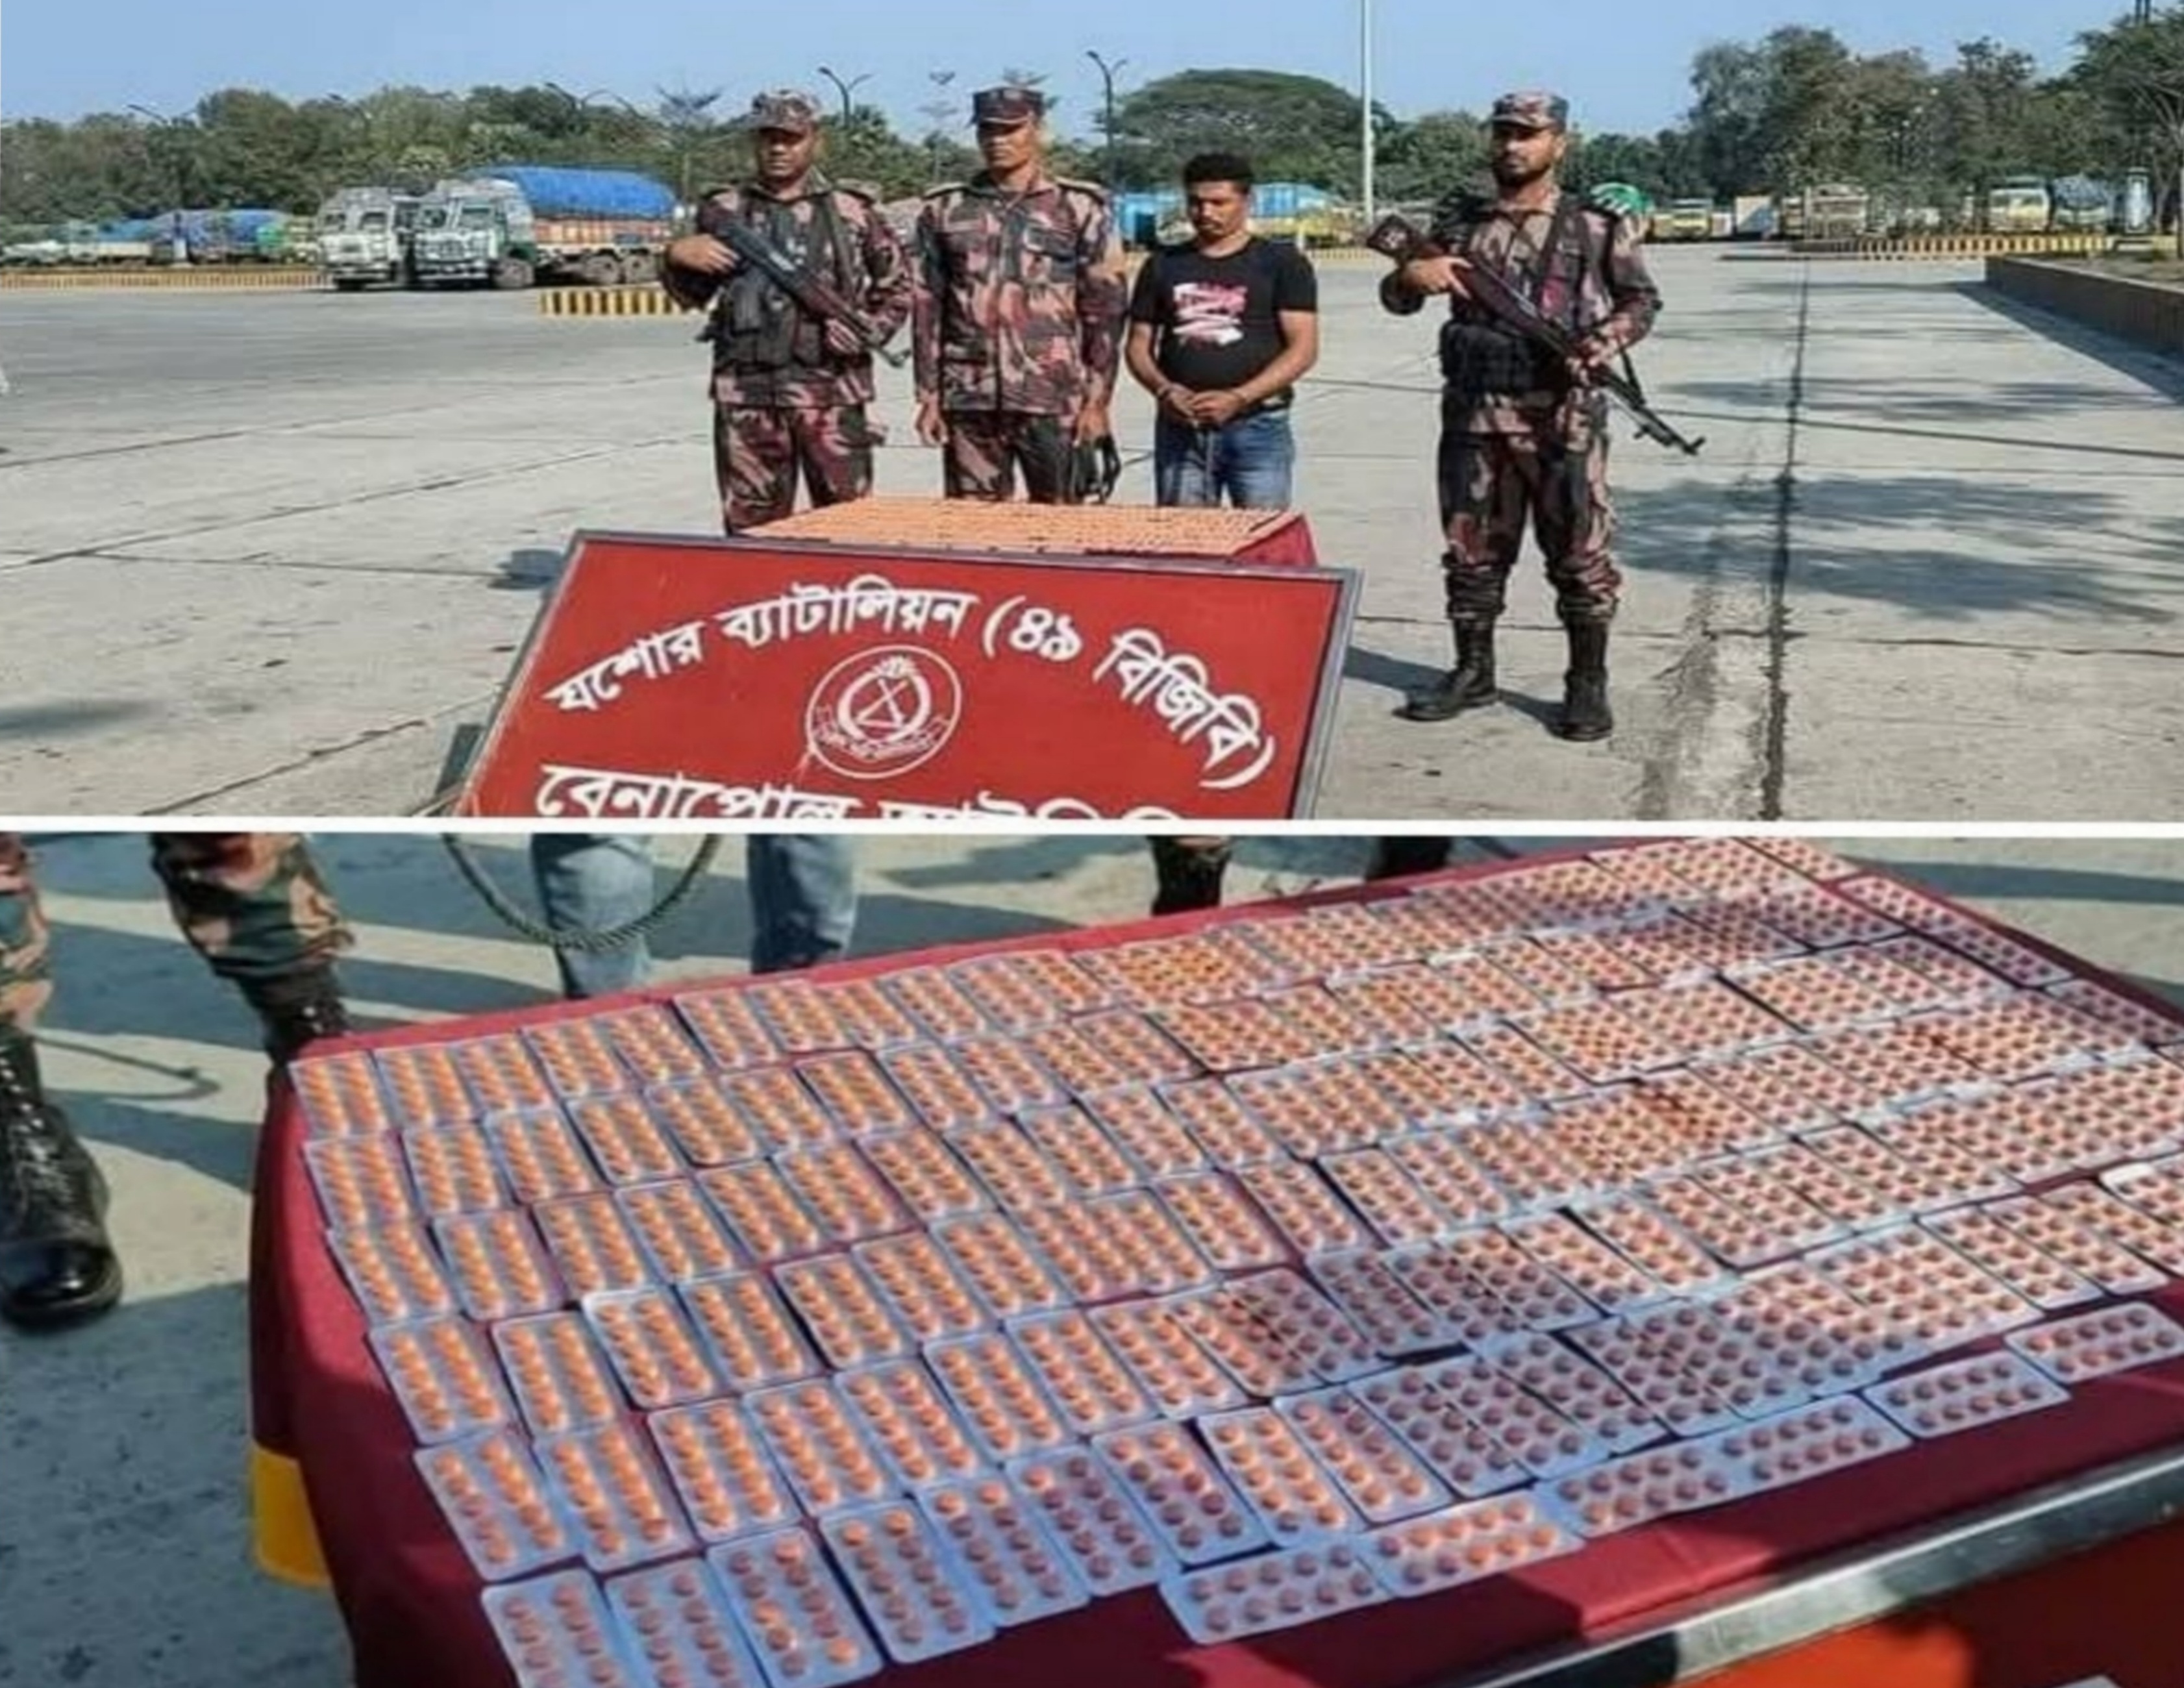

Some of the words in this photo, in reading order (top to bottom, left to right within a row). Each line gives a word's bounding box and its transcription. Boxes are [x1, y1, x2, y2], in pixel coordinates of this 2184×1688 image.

[541, 619, 706, 710] যশোর
[714, 573, 980, 647] ব্যাটালিয়ন
[982, 595, 1082, 661] (৪৯
[1093, 628, 1275, 789] বিজিবি)
